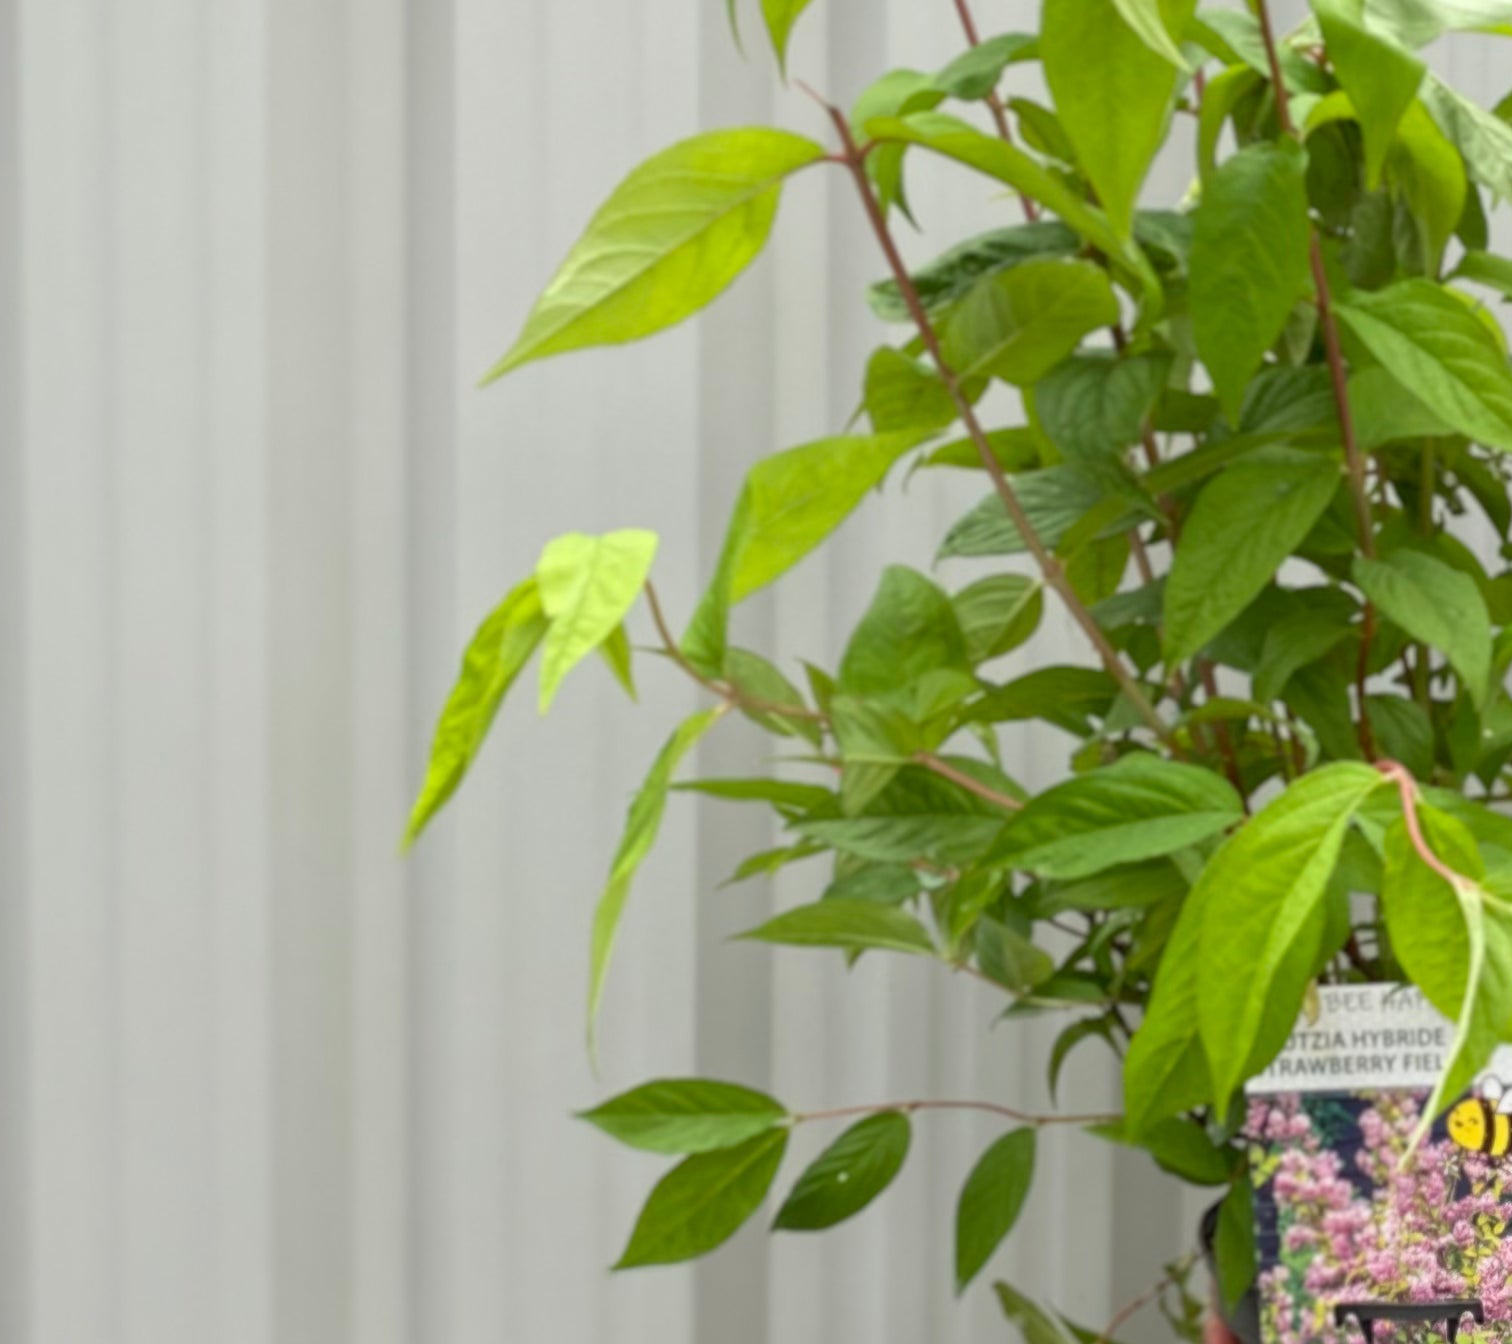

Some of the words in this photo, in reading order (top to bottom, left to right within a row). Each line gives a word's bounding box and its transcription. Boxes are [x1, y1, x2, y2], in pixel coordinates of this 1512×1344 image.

[1325, 990, 1373, 1014] BEE
[1283, 1029, 1345, 1052] UTZIA
[1352, 1026, 1445, 1048] HYBRIDE
[1268, 1056, 1397, 1078] TRAWBERRY
[1402, 1053, 1443, 1073] FIEL
